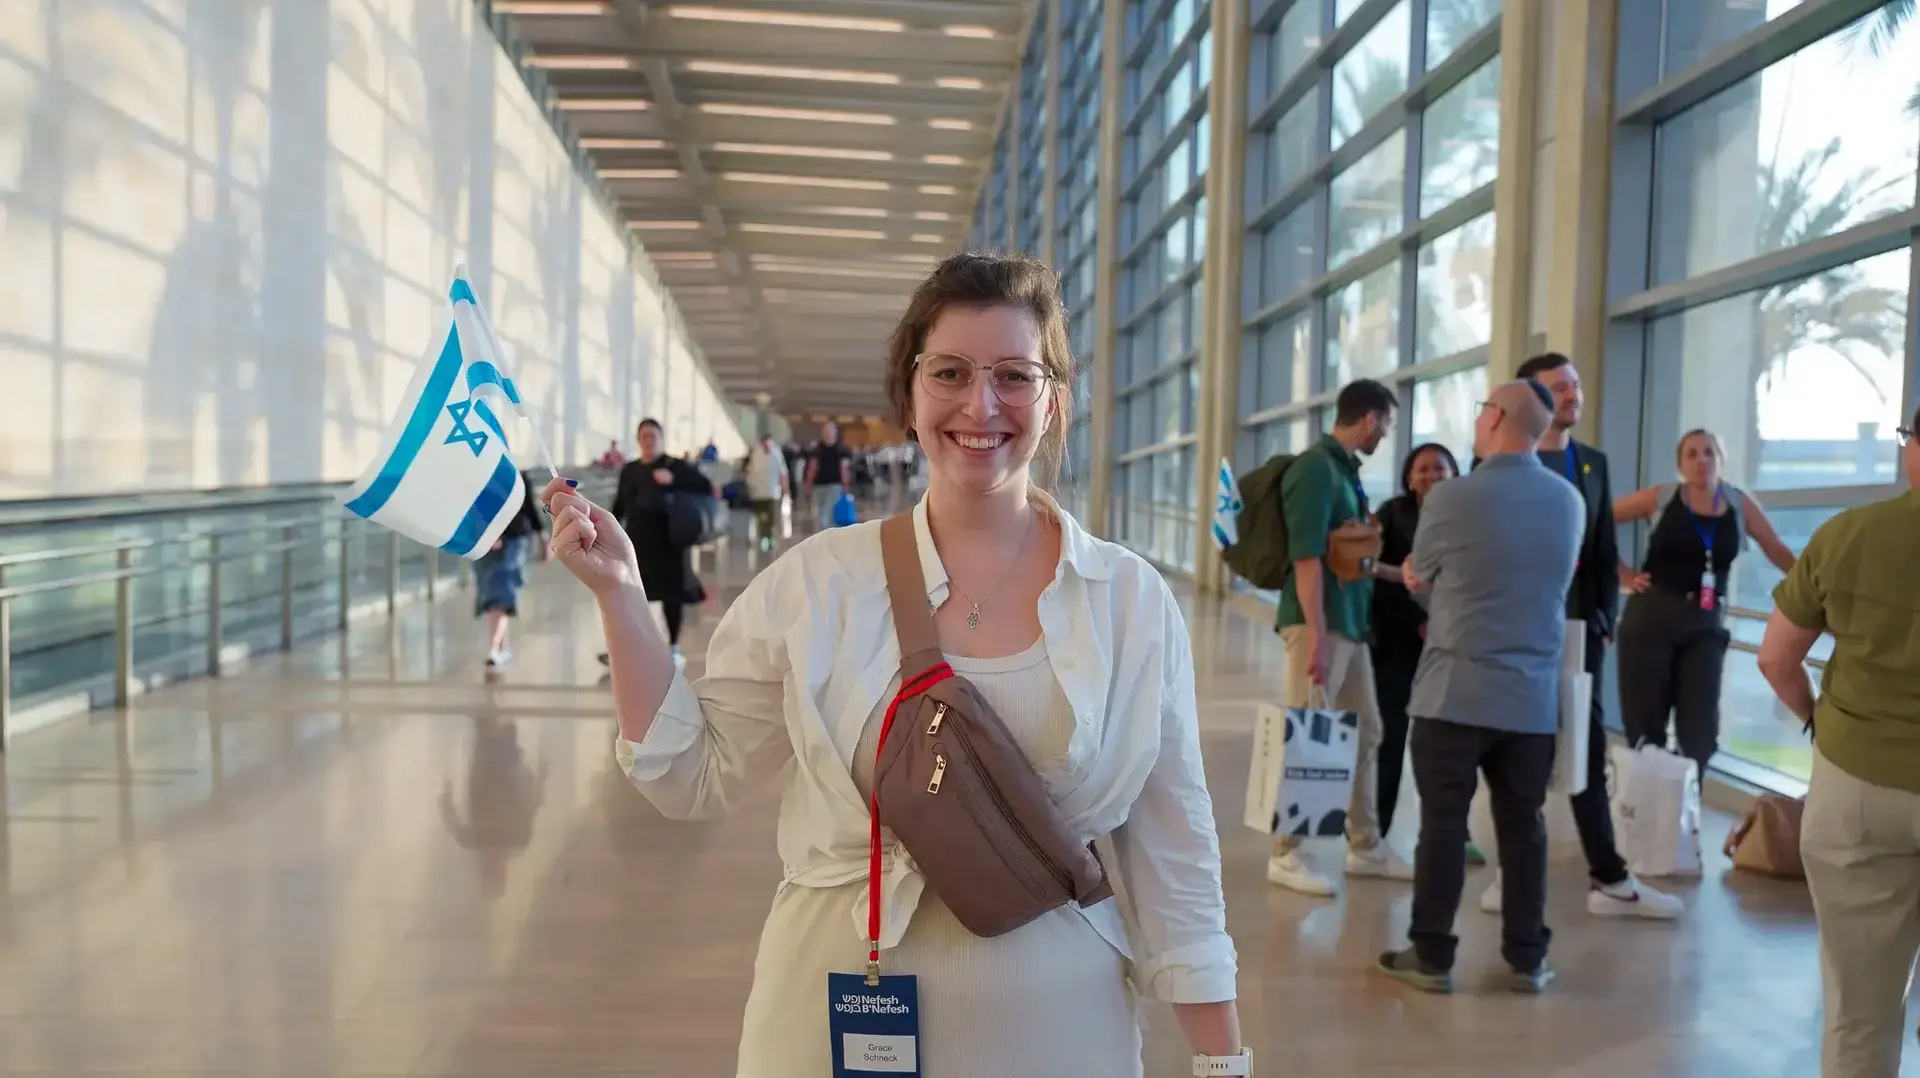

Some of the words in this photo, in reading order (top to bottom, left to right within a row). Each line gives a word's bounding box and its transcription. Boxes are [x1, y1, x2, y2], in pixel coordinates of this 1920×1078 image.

[861, 995, 899, 1005] Nefesh
[862, 1004, 909, 1014] B'Nefesh
[868, 1043, 893, 1052] Grace
[863, 1053, 898, 1062] Schneck
